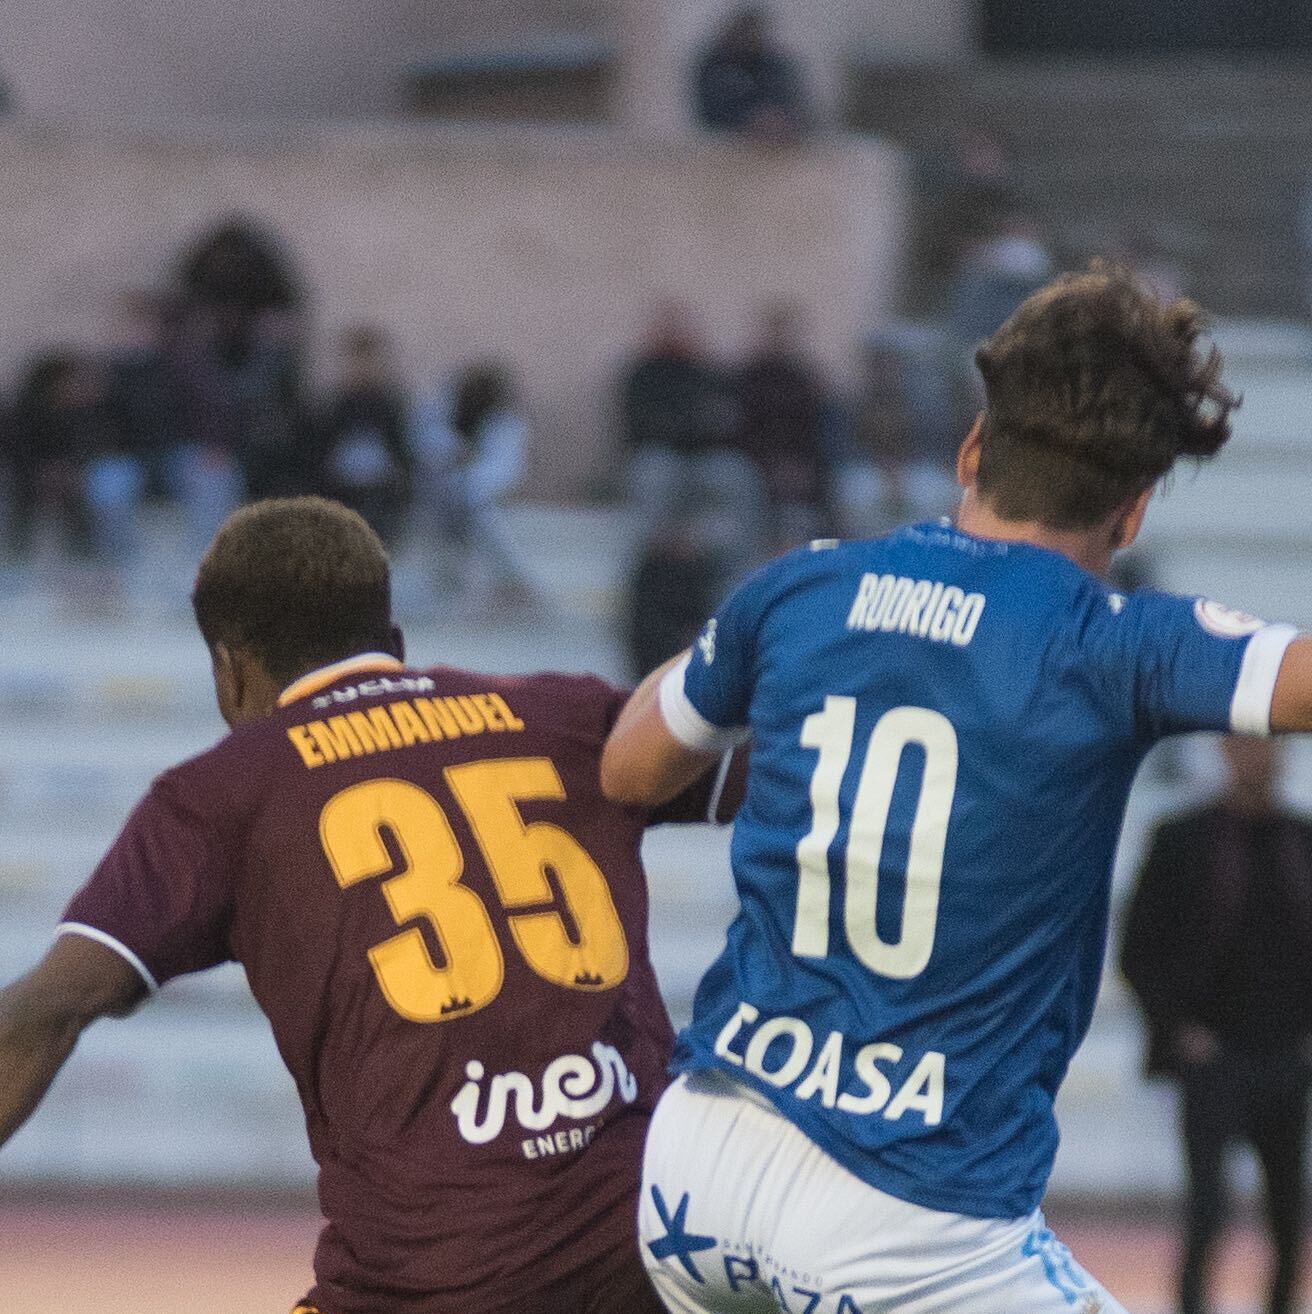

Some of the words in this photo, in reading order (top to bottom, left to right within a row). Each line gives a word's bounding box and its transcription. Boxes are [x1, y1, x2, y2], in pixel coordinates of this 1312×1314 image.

[846, 572, 986, 648] RODRIGO
[288, 692, 526, 769] EMMANUEL
[319, 756, 630, 1024] 35
[792, 695, 958, 979] 10
[714, 1001, 946, 1127] COASA
